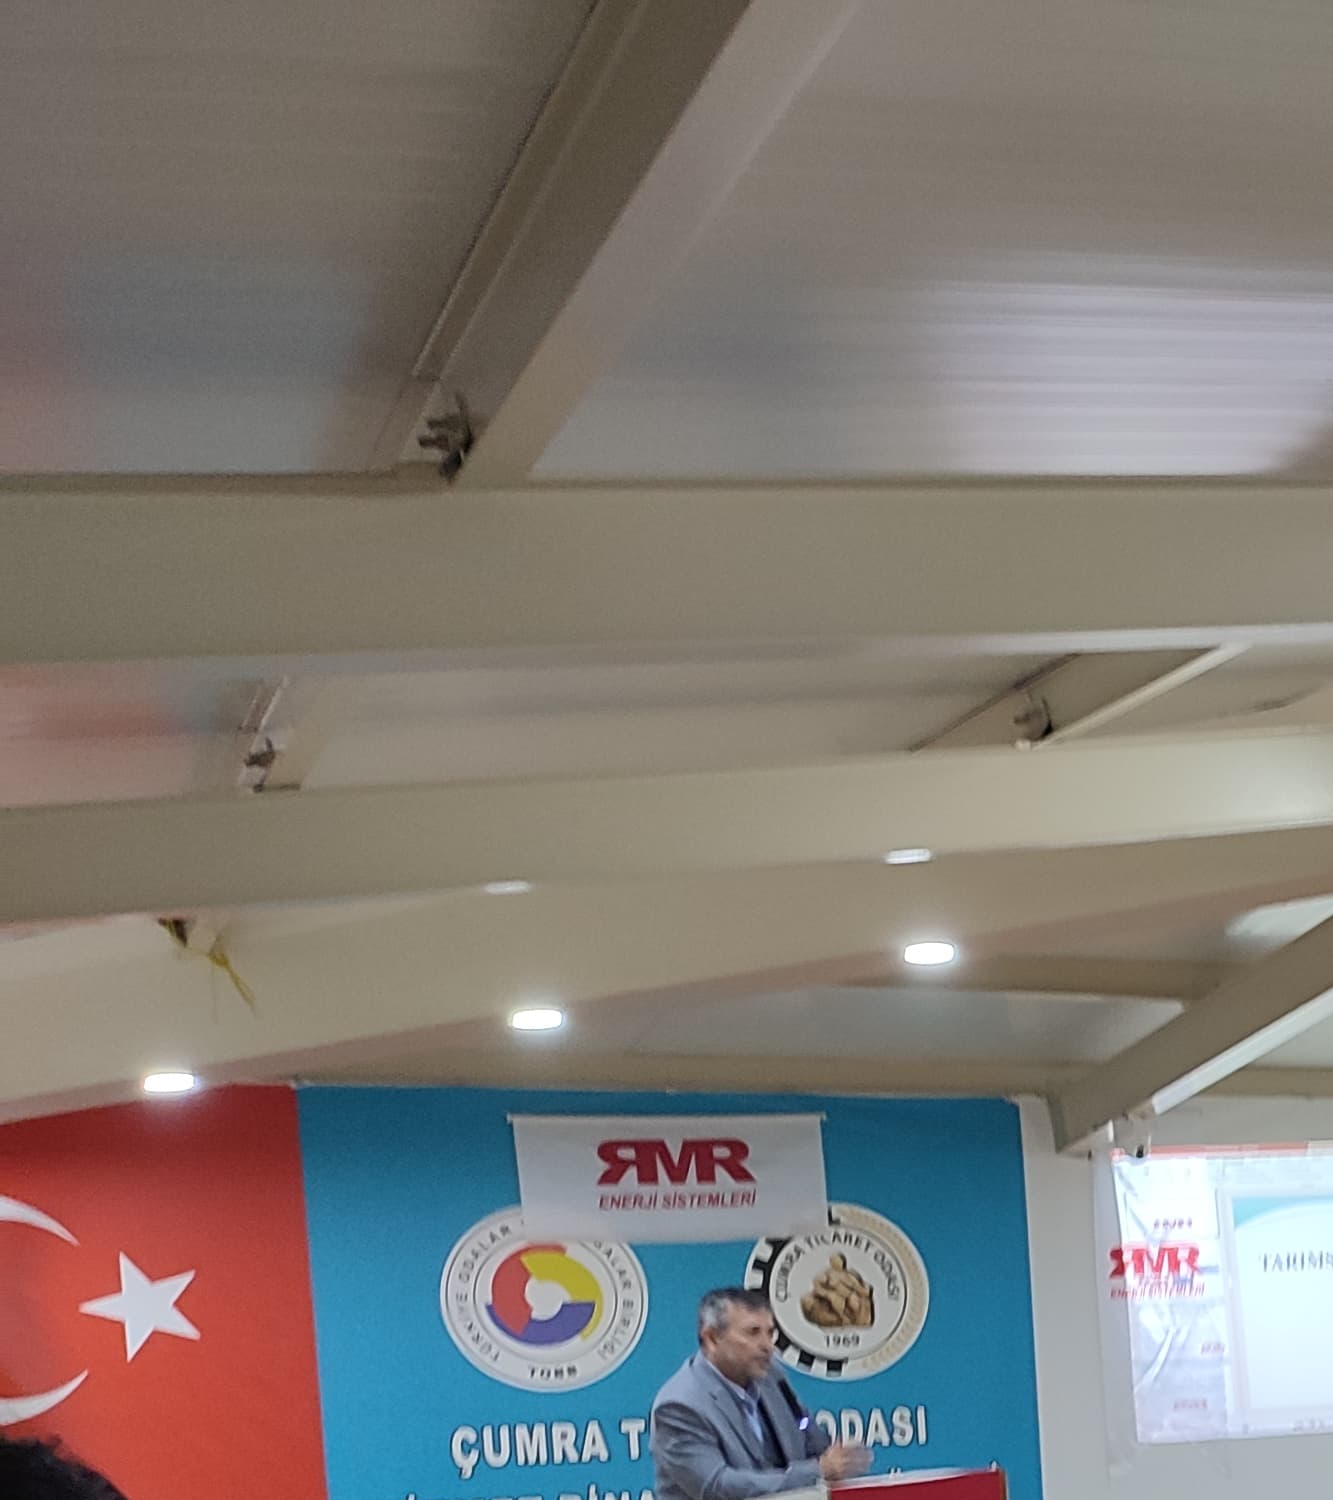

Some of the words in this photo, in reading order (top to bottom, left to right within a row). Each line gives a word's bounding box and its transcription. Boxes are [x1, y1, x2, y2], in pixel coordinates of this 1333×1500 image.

[598, 1190, 658, 1212] ENERJİ
[661, 1187, 758, 1211] SİSTEMLERİ
[823, 1332, 861, 1348] 1969
[450, 1418, 610, 1480] ÇUMRA
